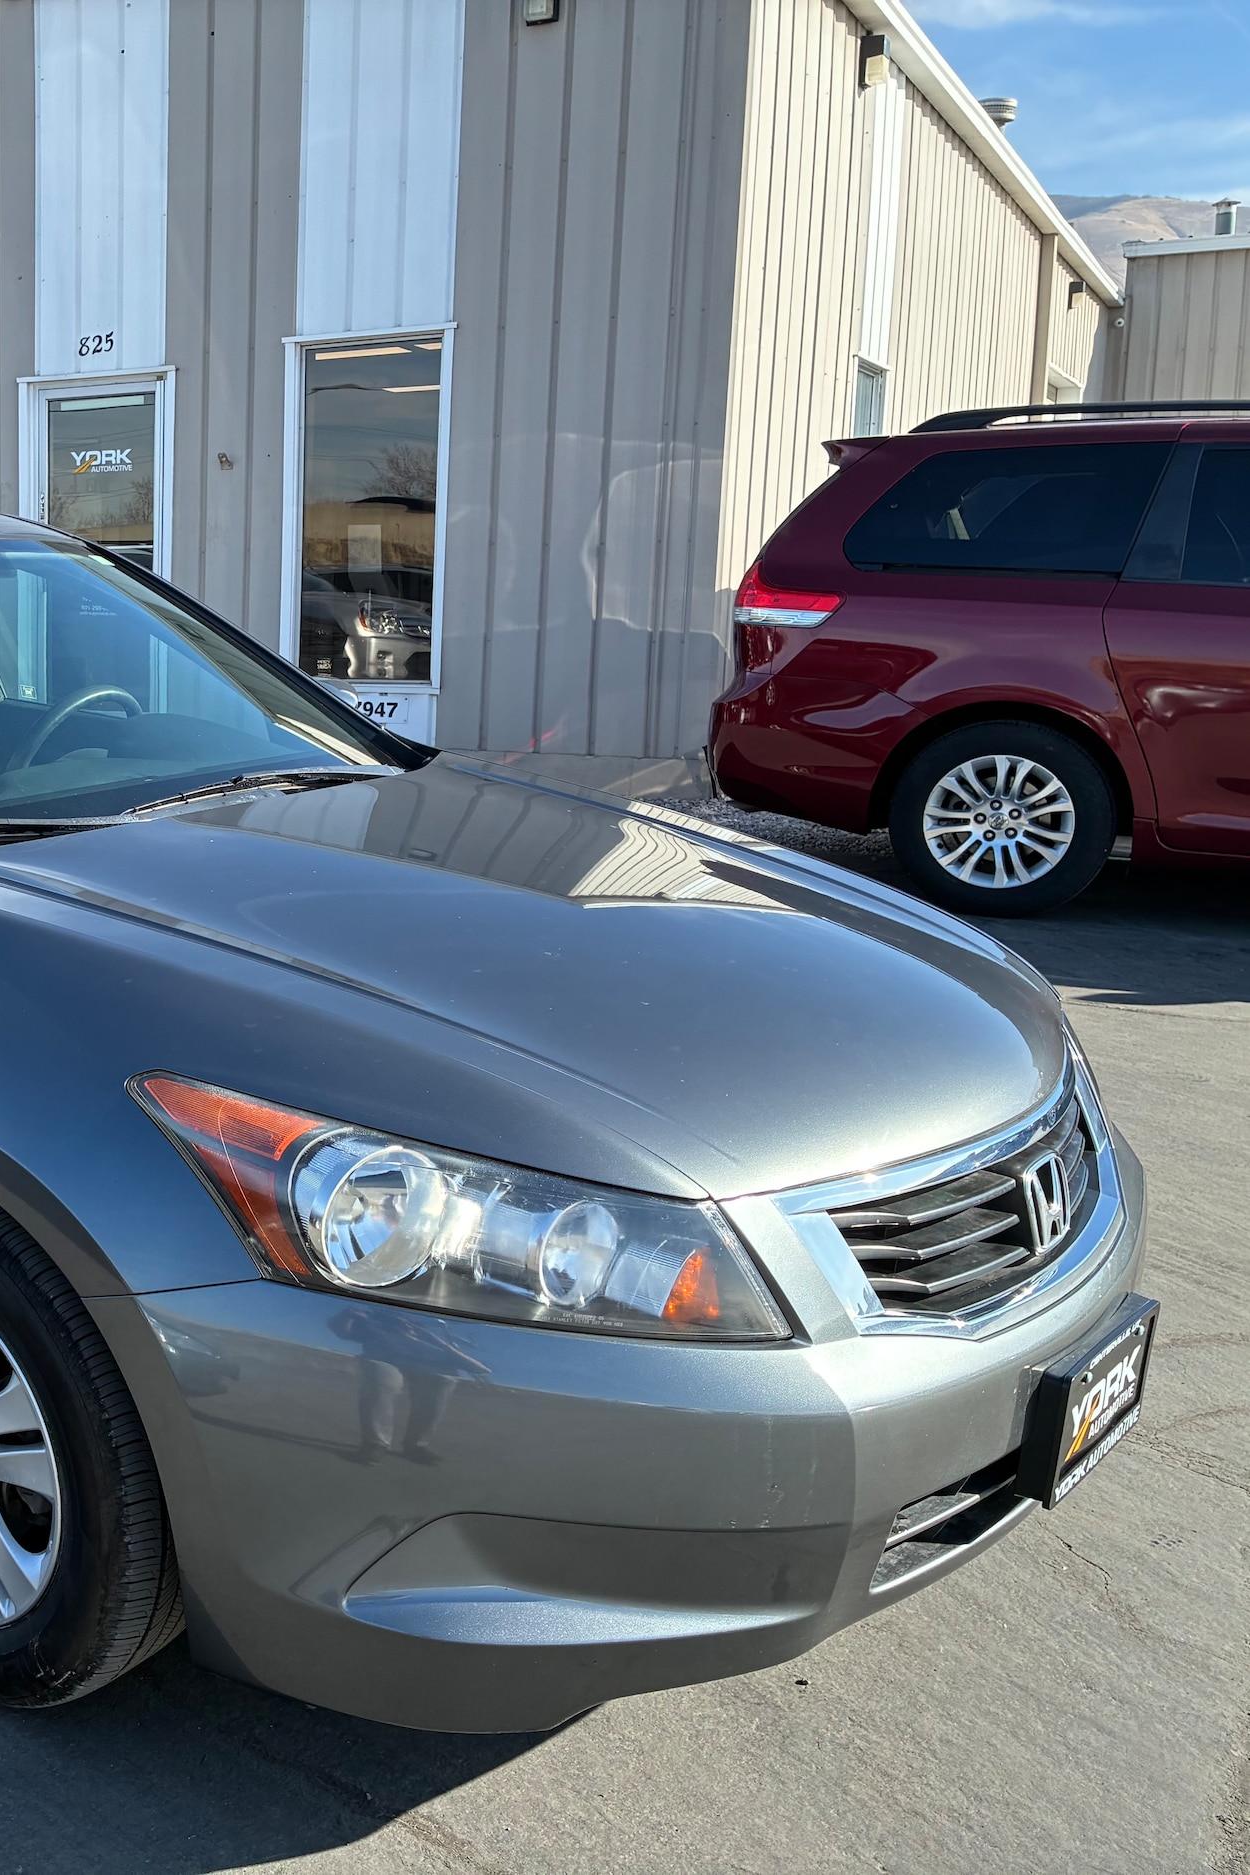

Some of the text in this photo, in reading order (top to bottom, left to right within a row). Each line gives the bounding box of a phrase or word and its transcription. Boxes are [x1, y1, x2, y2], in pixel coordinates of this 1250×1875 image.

[78, 331, 114, 357] 825
[70, 448, 132, 466] YORK
[90, 464, 133, 473] AUTOMOTIVE
[1071, 1344, 1141, 1438] YORK
[1087, 1382, 1136, 1440] AUTOMOTIVE
[1054, 1404, 1141, 1502] YORK AUTOMOTIVE
